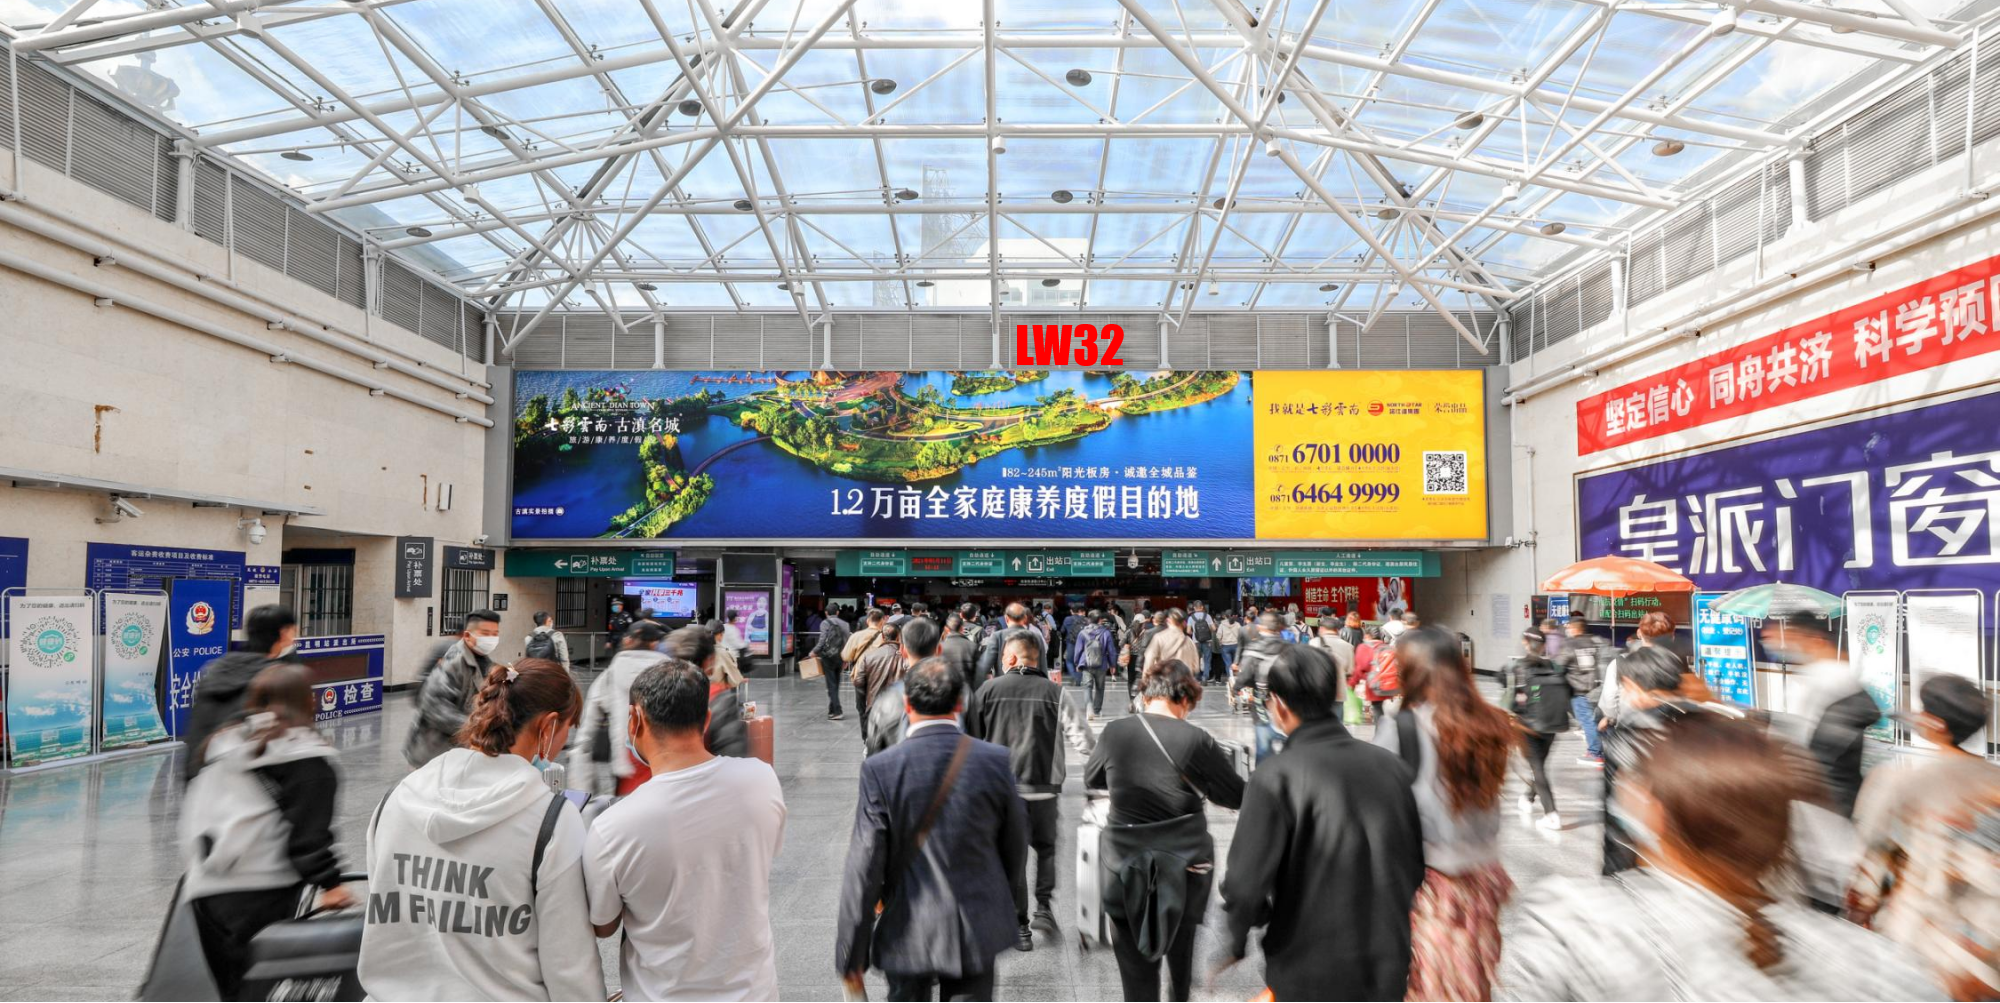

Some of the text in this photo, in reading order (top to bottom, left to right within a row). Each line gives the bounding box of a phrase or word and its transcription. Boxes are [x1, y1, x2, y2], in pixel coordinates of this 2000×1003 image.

[1605, 274, 2000, 437] 坚定信心 同舟共济 科学预
[571, 402, 605, 411] ANCIENT
[609, 402, 628, 410] DIAN
[630, 402, 655, 410] TOWN
[1269, 443, 1400, 464] 0871 6701 0000
[1270, 483, 1400, 503] 0871 6464 9999
[1619, 450, 2000, 574] 皇派门窗
[468, 551, 483, 560] 补票处
[590, 556, 617, 565] 补票处
[1046, 556, 1072, 565] 出站口
[1246, 557, 1272, 566] 出站口
[412, 560, 423, 586] 补票处
[1305, 586, 1329, 603] 创造生命
[172, 645, 223, 658] 公安 POLICE
[343, 682, 374, 706] 检查
[315, 709, 343, 722] POLICE
[393, 852, 495, 900] THINK
[410, 894, 532, 938] FAILING
